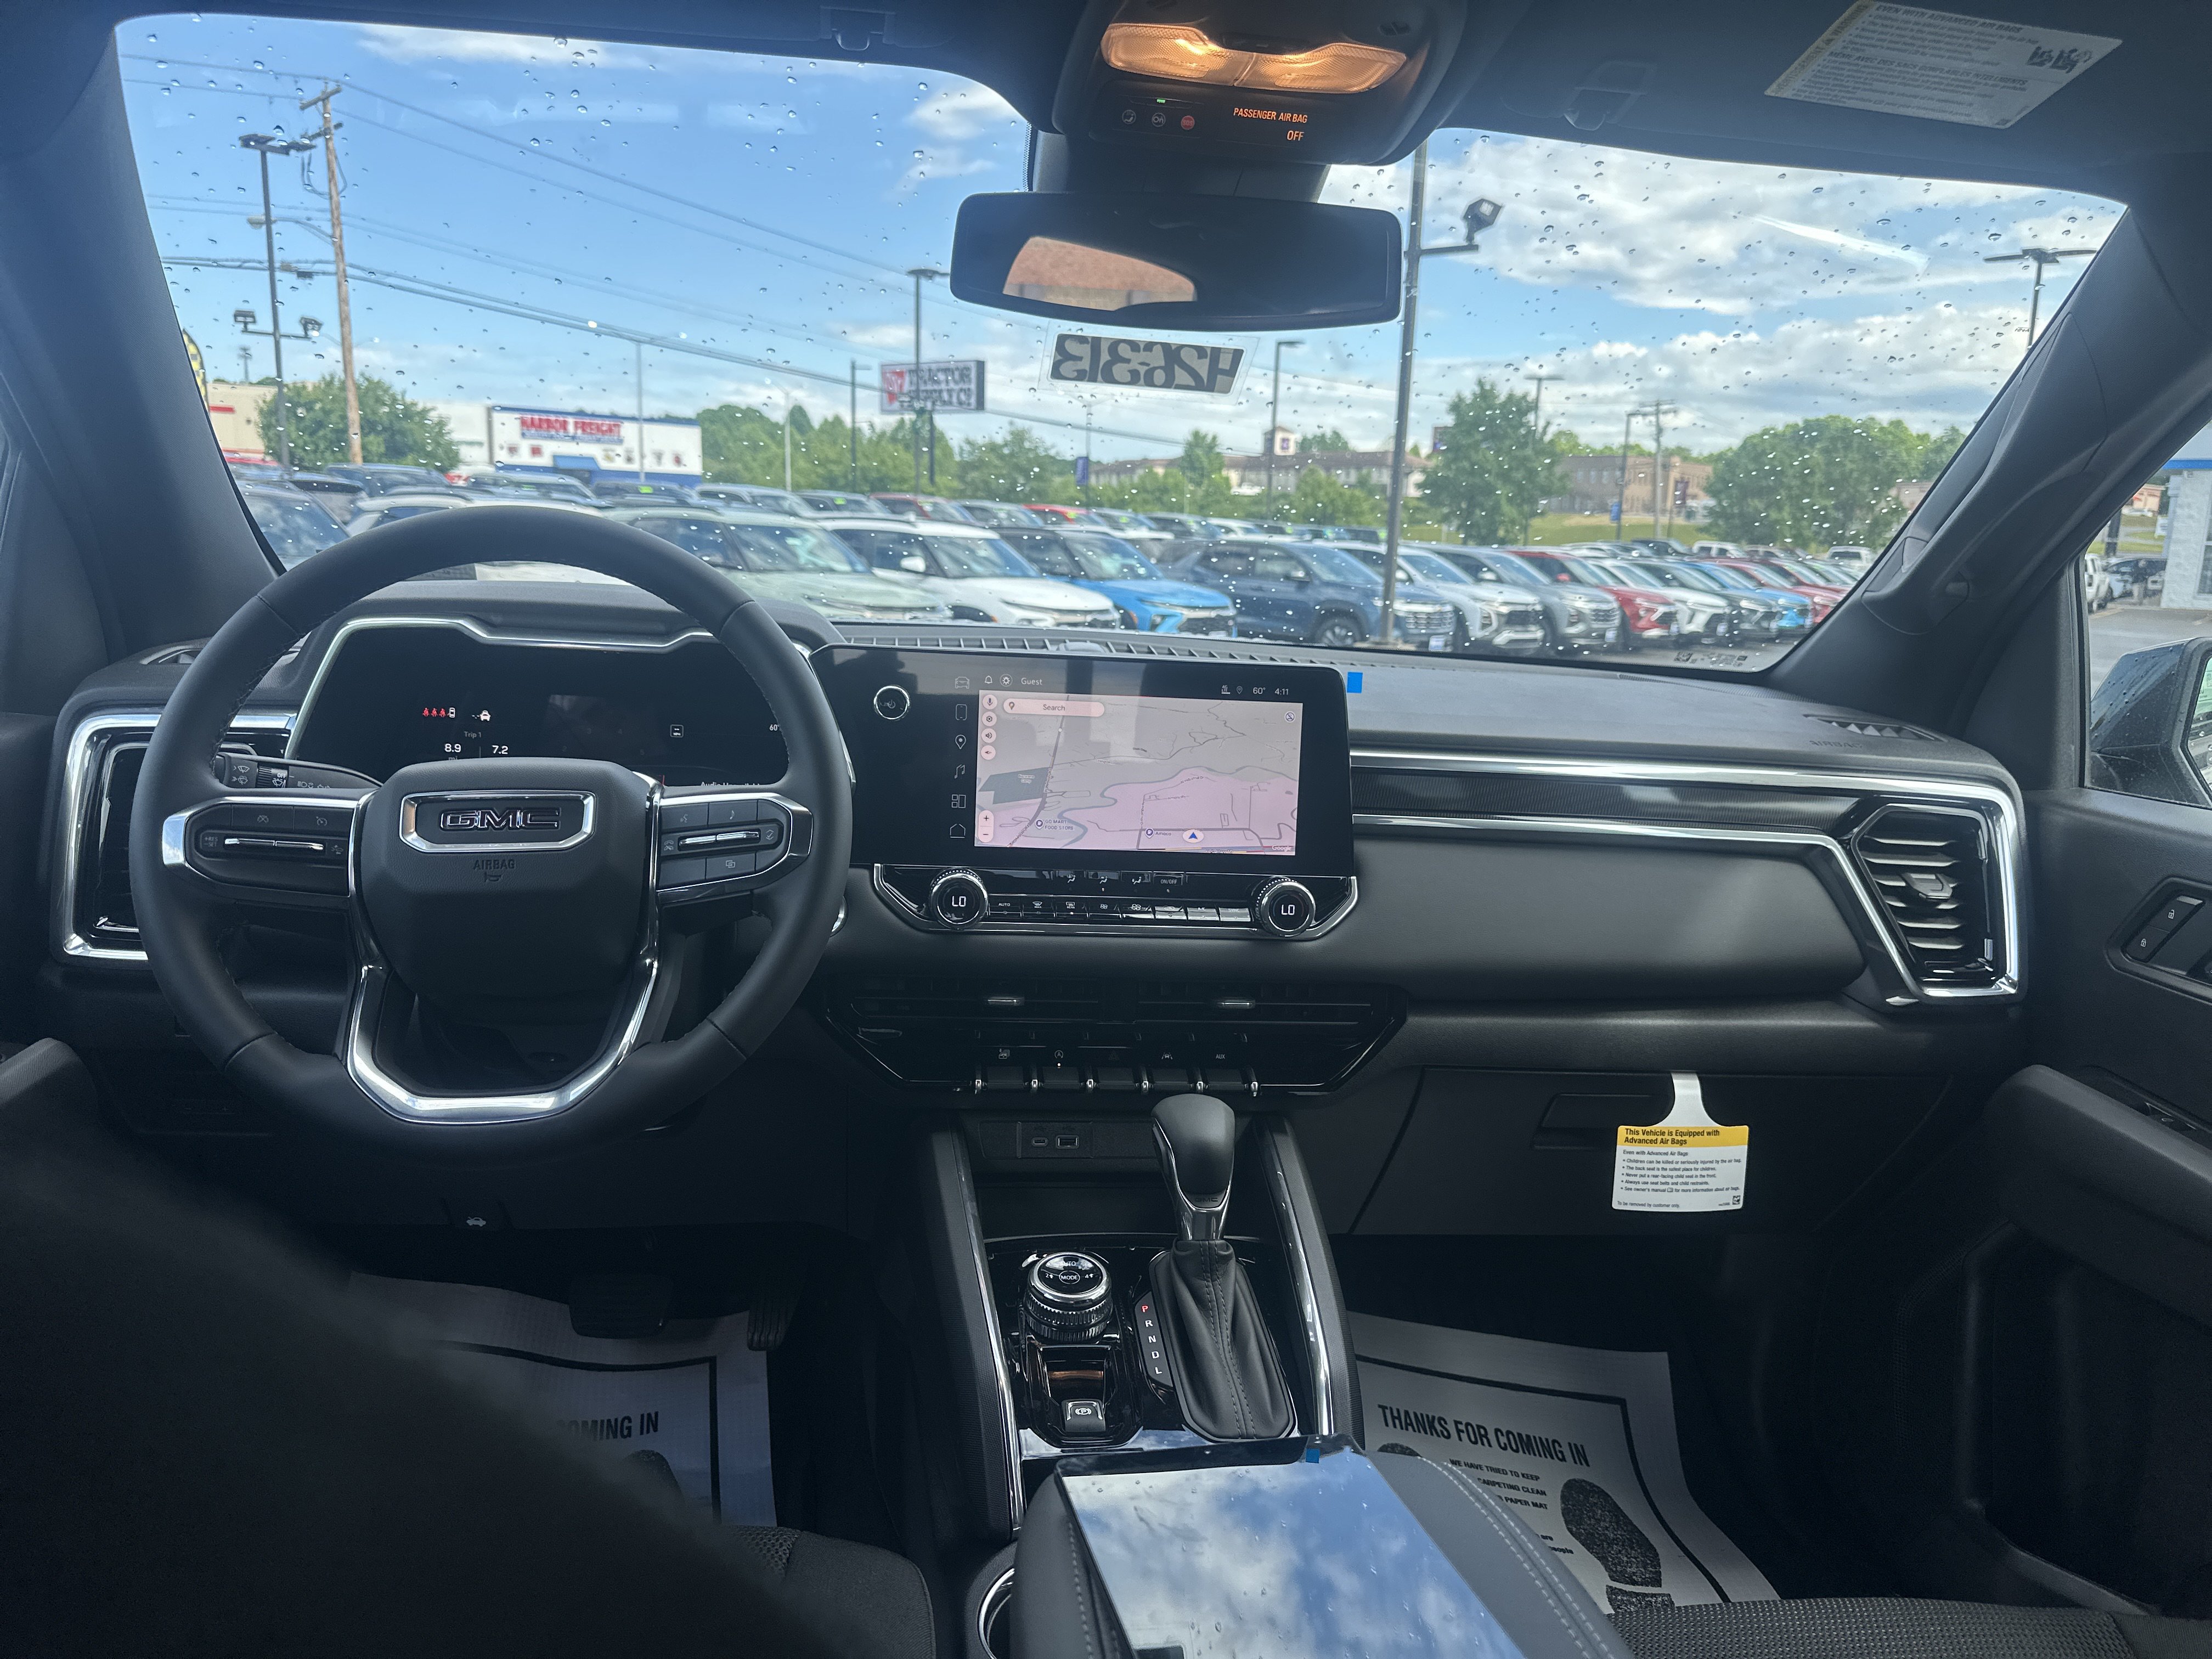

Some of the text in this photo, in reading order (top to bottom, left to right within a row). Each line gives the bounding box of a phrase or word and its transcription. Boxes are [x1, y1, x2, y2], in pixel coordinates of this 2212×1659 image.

[1233, 108, 1276, 120] PASSENGER
[1292, 115, 1308, 123] BAG
[1286, 130, 1305, 141] OFF
[1021, 677, 1043, 686] Guest
[444, 743, 461, 752] 8.9
[492, 745, 508, 754] 7.2
[440, 806, 562, 831] GMC
[474, 859, 516, 871] AIRBAG
[952, 896, 966, 907] LO
[1282, 904, 1295, 915] LO
[1675, 1129, 1705, 1137] Equipped
[640, 1411, 659, 1435] IN
[1378, 1404, 1590, 1468] THANKS FOR COMING IN
[1449, 1458, 1462, 1466] WE
[1464, 1462, 1484, 1470] HAVE
[1485, 1465, 1508, 1475] TRIED
[1521, 1472, 1540, 1481] KEEP
[1522, 1486, 1547, 1496] CLEAN
[1505, 1497, 1530, 1506] PAPER
[1531, 1501, 1548, 1509] MAT
